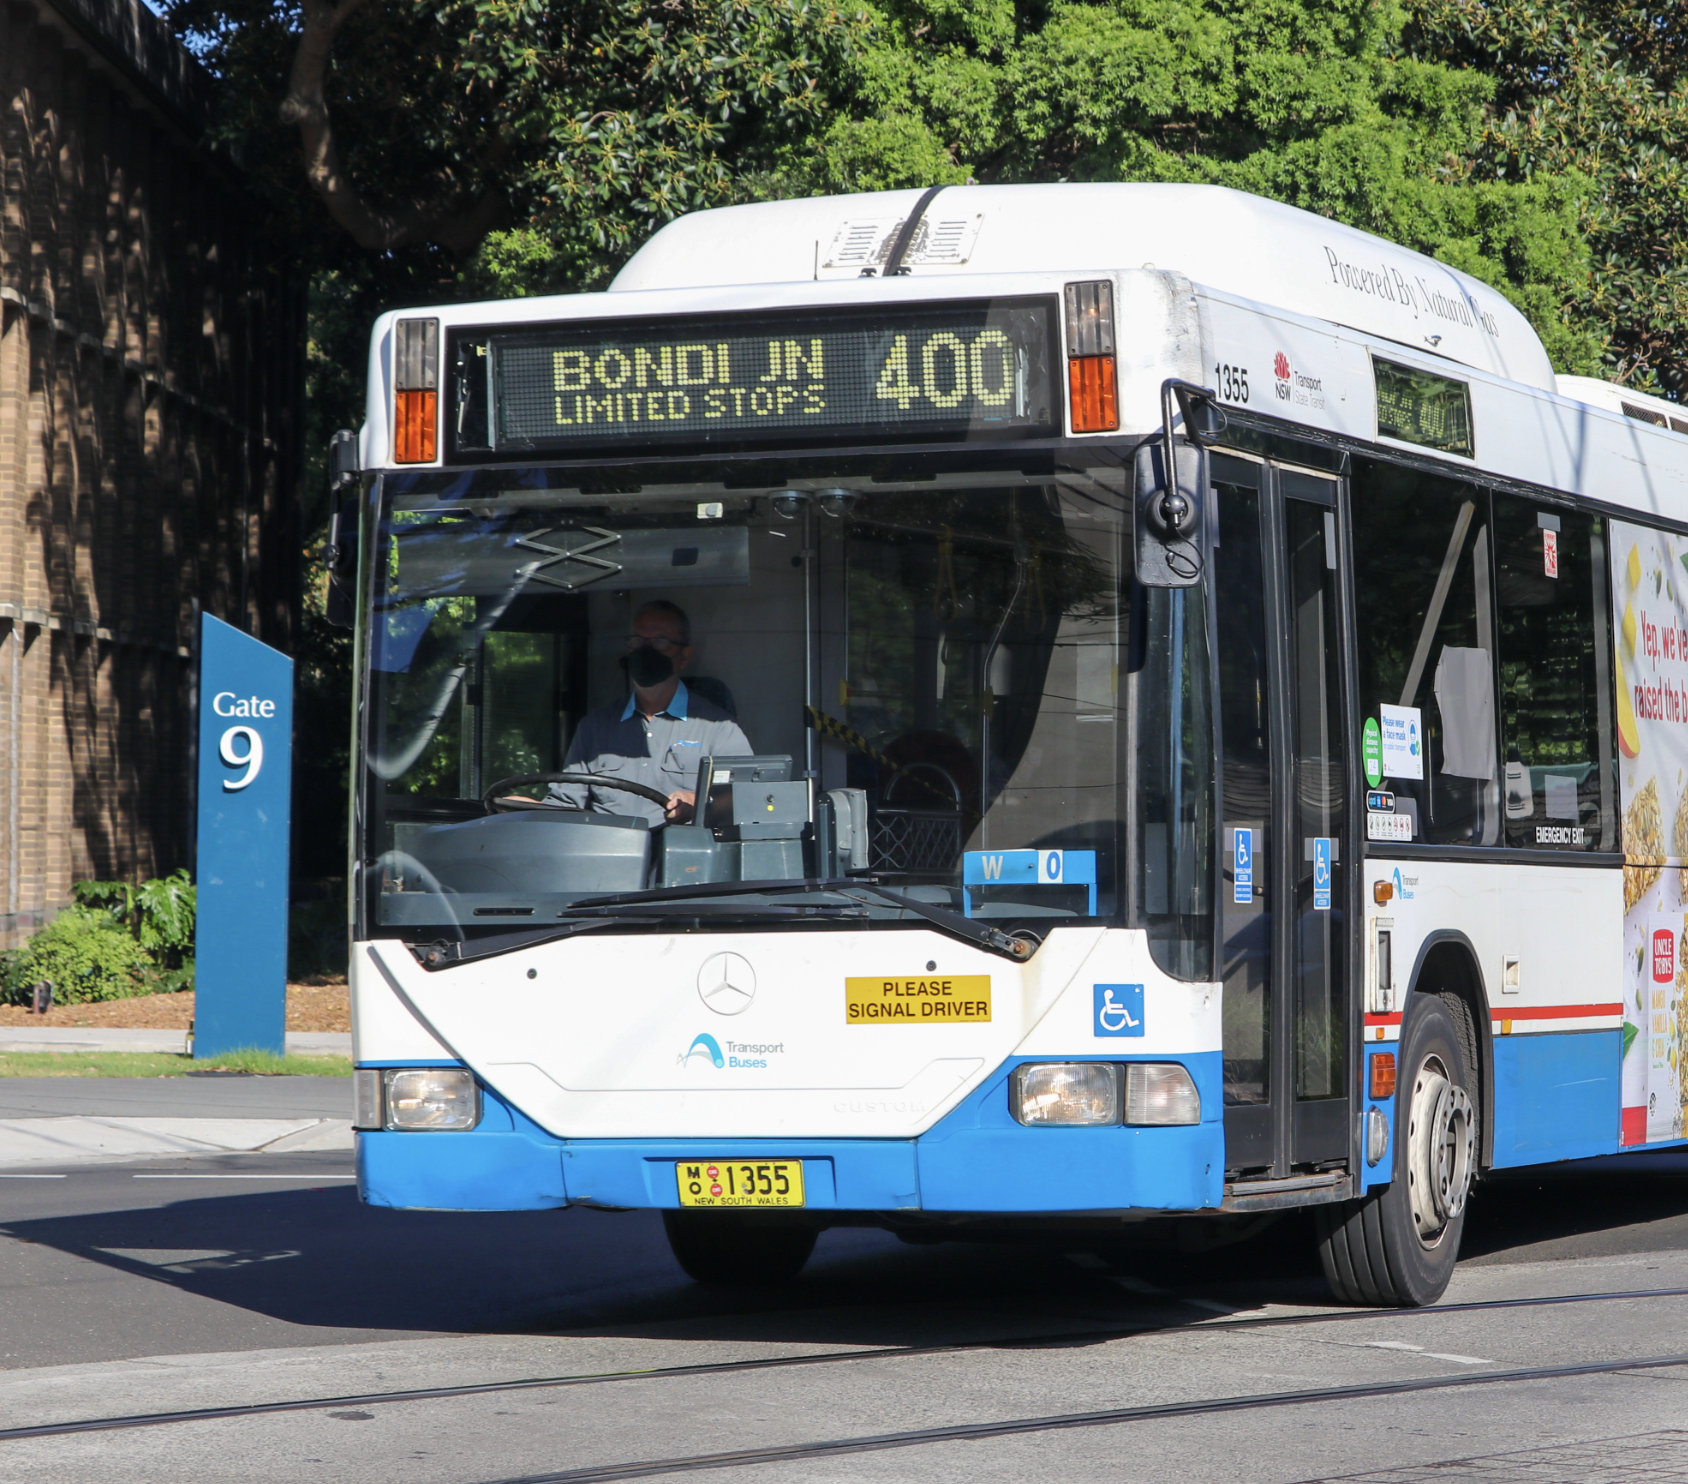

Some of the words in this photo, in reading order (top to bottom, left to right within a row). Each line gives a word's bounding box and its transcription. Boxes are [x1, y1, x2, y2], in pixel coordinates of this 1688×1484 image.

[1324, 245, 1395, 302] Powered
[1390, 268, 1418, 319] By
[1414, 275, 1473, 328] Natural
[1468, 295, 1499, 338] Gas
[553, 343, 730, 391] BONDI
[760, 339, 824, 381] JN
[876, 330, 1015, 409] 400
[1215, 362, 1249, 404] 1355
[1275, 382, 1291, 402] NSW
[1294, 371, 1322, 393] Transport
[554, 391, 690, 424] LIMITED
[704, 384, 826, 419] STOPS
[1640, 609, 1661, 672] Yep,
[1661, 614, 1688, 662] we've
[213, 691, 276, 718] Gate
[1634, 676, 1663, 721] raised
[1665, 677, 1680, 723] the
[1382, 715, 1395, 728] Please
[1395, 719, 1405, 728] wear
[1386, 727, 1395, 740] face
[1395, 730, 1406, 741] mask
[219, 725, 263, 792] 9
[1536, 826, 1571, 844] EMERGENCY
[1572, 828, 1584, 844] EXIT
[981, 855, 1004, 880] W
[1655, 938, 1672, 956] UNCLE
[1655, 957, 1672, 975] TOBYS
[883, 981, 952, 997] PLEASE
[849, 1002, 916, 1018] SIGNAL
[921, 1001, 988, 1017] DRIVER
[726, 1041, 784, 1056] Transport
[729, 1056, 767, 1068] Buses
[726, 1166, 790, 1195] 1355
[694, 1198, 715, 1206] NEW
[721, 1197, 752, 1205] SOUTH
[757, 1197, 788, 1205] WALES
